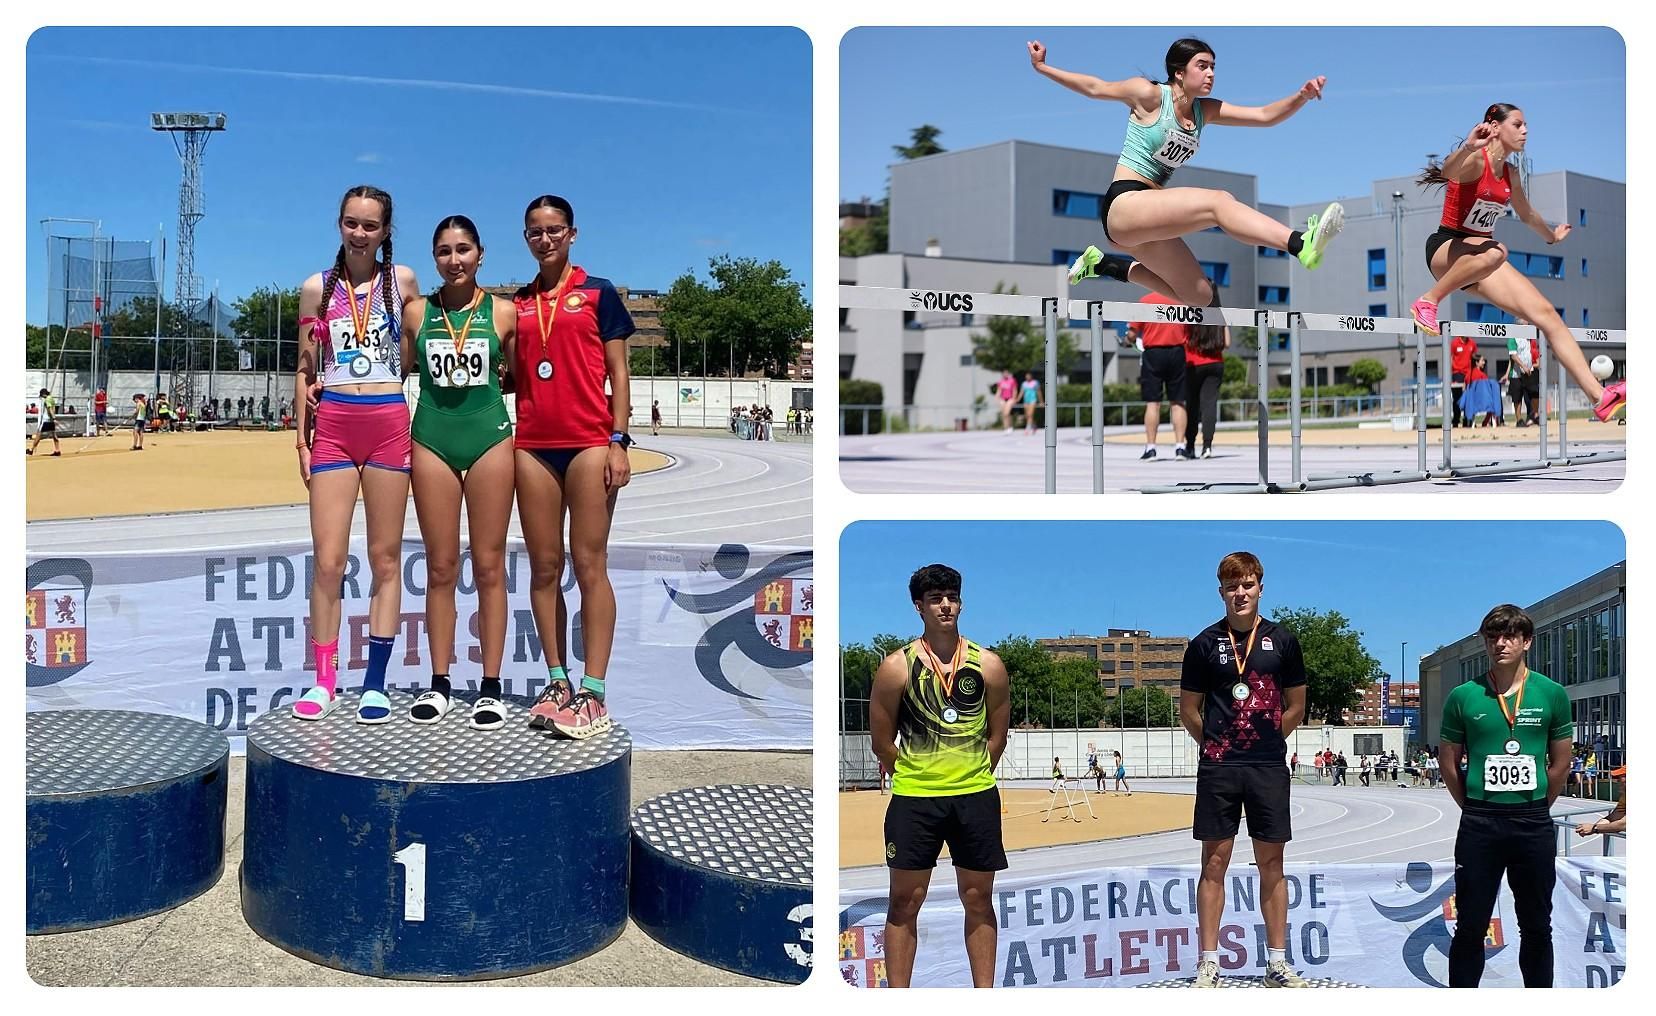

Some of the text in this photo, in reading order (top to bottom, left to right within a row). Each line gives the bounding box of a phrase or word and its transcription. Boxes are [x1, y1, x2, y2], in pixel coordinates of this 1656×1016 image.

[938, 293, 973, 312] UCS
[1177, 307, 1203, 323] UCS
[1354, 317, 1375, 332] UCS
[1490, 325, 1507, 337] UCS
[1595, 330, 1608, 341] UCS
[431, 353, 482, 378] 3089
[1489, 765, 1530, 785] 3093
[393, 842, 426, 921] 1
[999, 875, 1255, 929] FEDERACIN
[783, 903, 814, 968] 3
[1002, 921, 1330, 988] ATLETSMO
